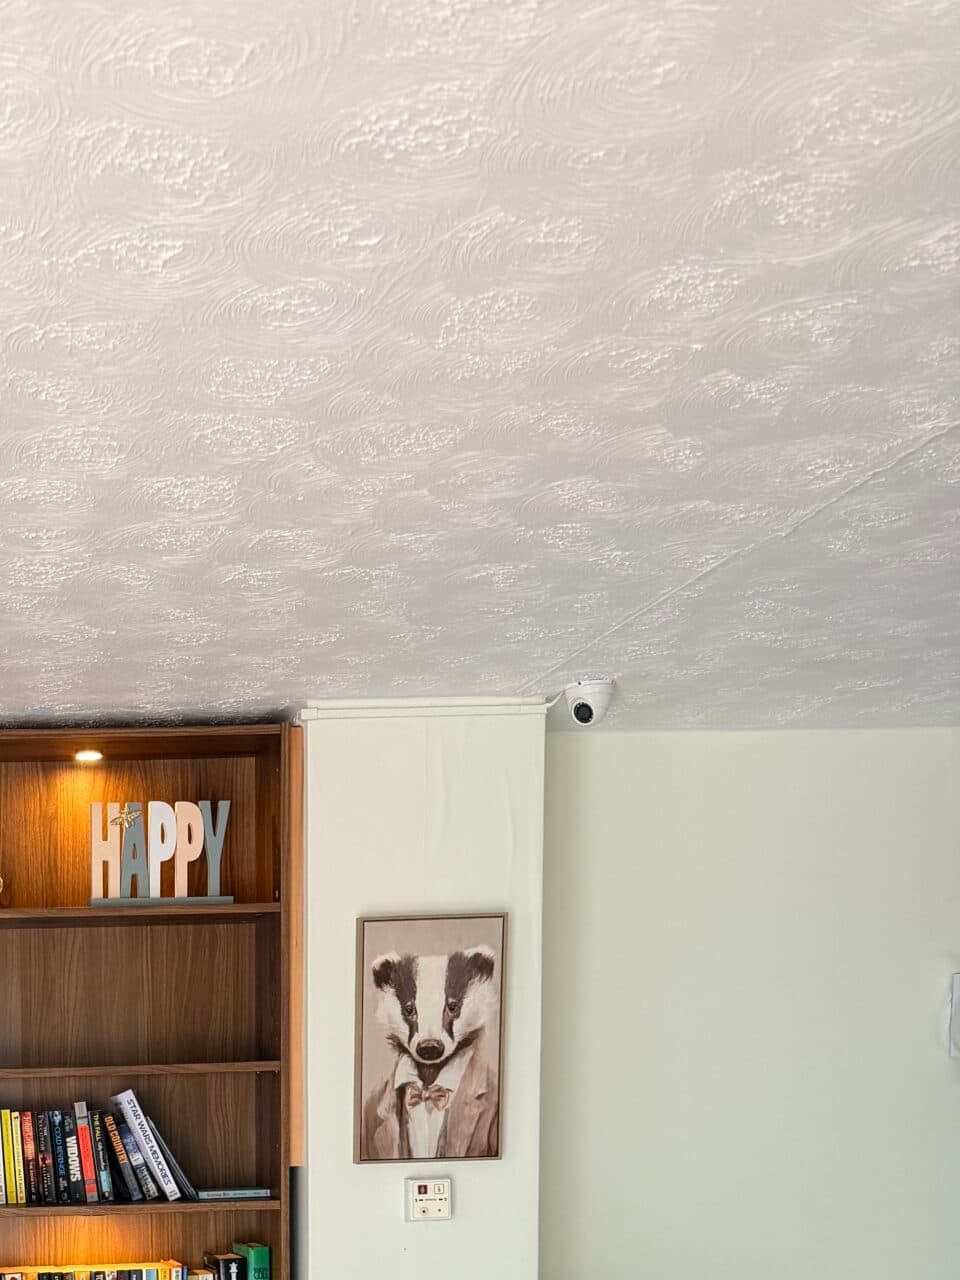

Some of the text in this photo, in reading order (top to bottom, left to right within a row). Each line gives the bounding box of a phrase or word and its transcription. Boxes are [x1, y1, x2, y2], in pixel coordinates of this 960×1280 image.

[90, 801, 231, 898] HAPPY
[54, 1127, 63, 1146] COLD
[66, 1136, 81, 1182] WIDOWS
[104, 1116, 129, 1164] OLD COUNTRY
[127, 1099, 172, 1186] STAR WARS MEMORIES
